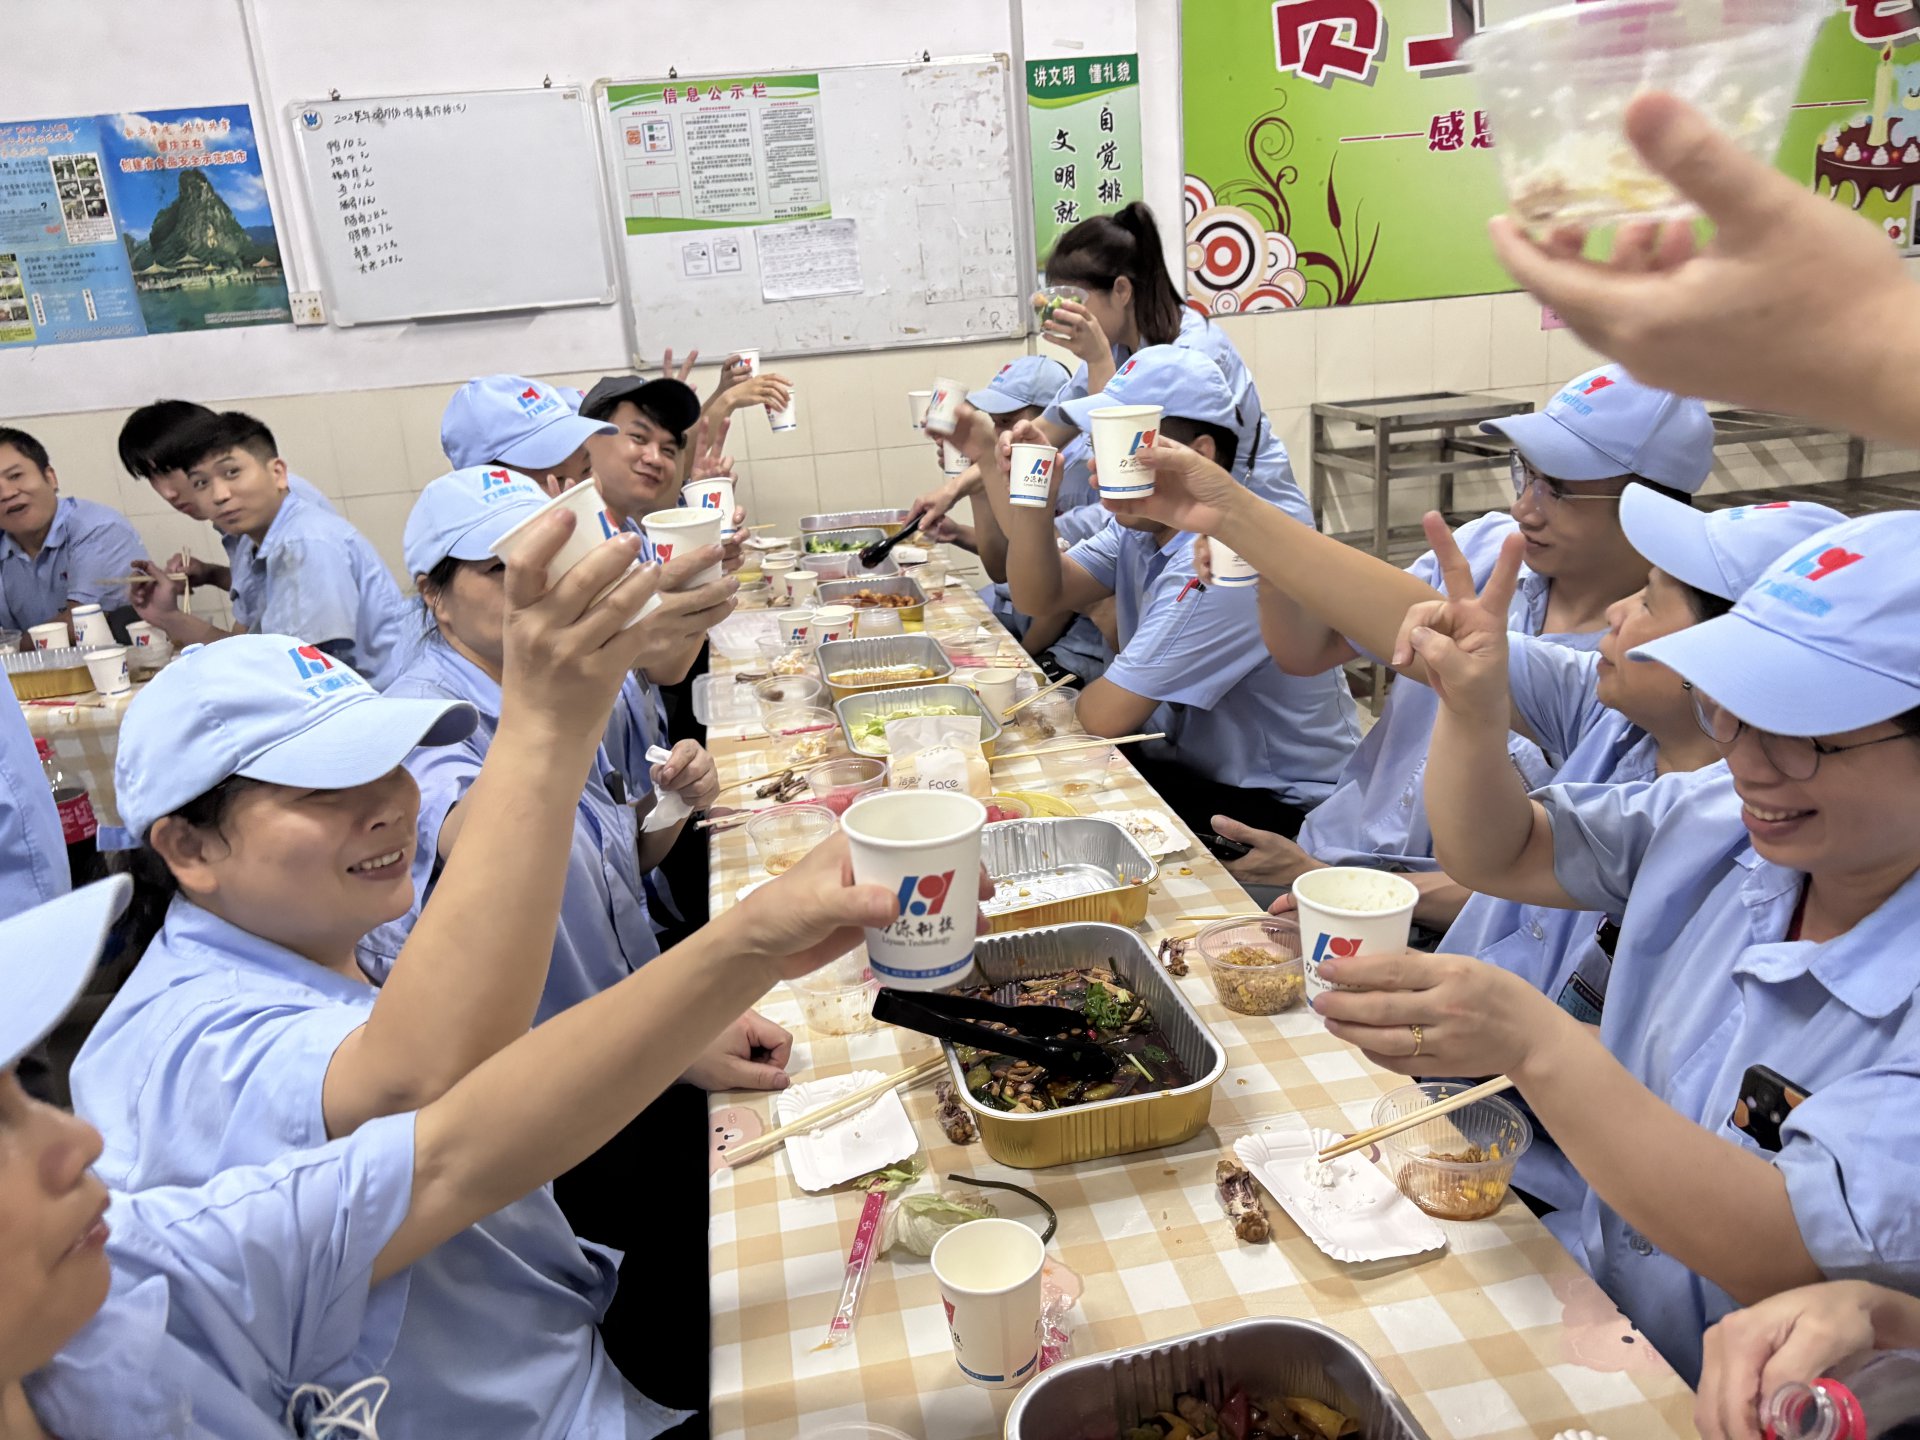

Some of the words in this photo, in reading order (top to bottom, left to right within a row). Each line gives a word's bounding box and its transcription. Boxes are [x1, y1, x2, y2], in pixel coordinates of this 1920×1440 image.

[1033, 64, 1077, 88] 讲文明
[1088, 60, 1132, 85] 懂礼貌
[662, 83, 769, 105] 信息公示栏
[1096, 107, 1124, 204] 自觉排
[1049, 128, 1081, 224] 文明就
[928, 778, 959, 791] Face
